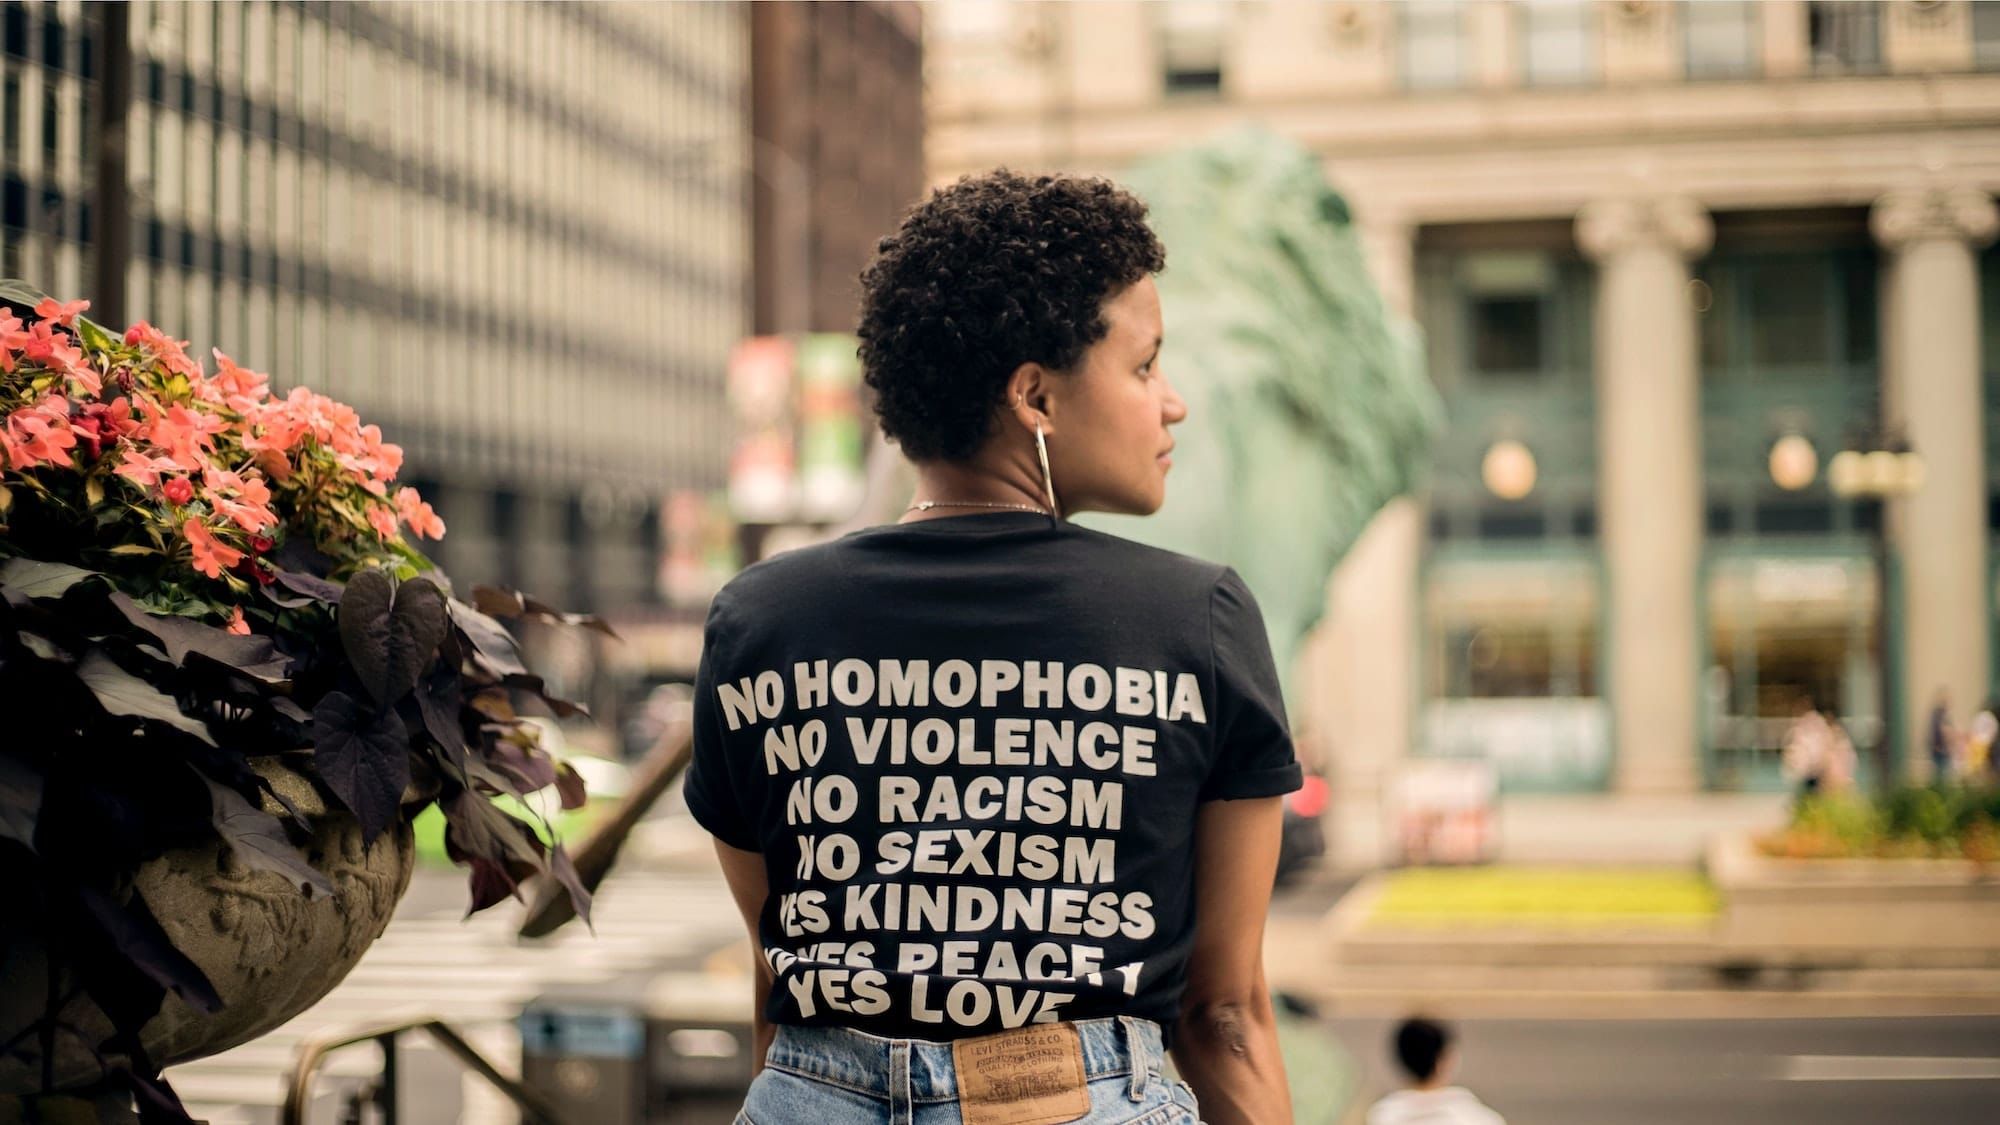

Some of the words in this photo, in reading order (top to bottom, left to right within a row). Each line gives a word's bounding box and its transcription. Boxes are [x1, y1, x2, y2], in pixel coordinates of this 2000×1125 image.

[717, 670, 785, 731] NO
[793, 658, 1207, 724] HOMOPHOBIA
[764, 719, 828, 776] NO
[845, 716, 1157, 777] VIOLENCE
[787, 774, 859, 826] NO
[879, 775, 1123, 831] RACISM
[796, 833, 861, 881] NO
[876, 831, 1116, 885] SEXISM
[779, 889, 831, 938] YES
[843, 883, 1156, 940] KINDNESS
[787, 969, 891, 1018] YES
[970, 1045, 992, 1055] LEVI
[996, 1036, 1037, 1050] STRAUSS
[978, 1063, 1017, 1074] QUALITY
